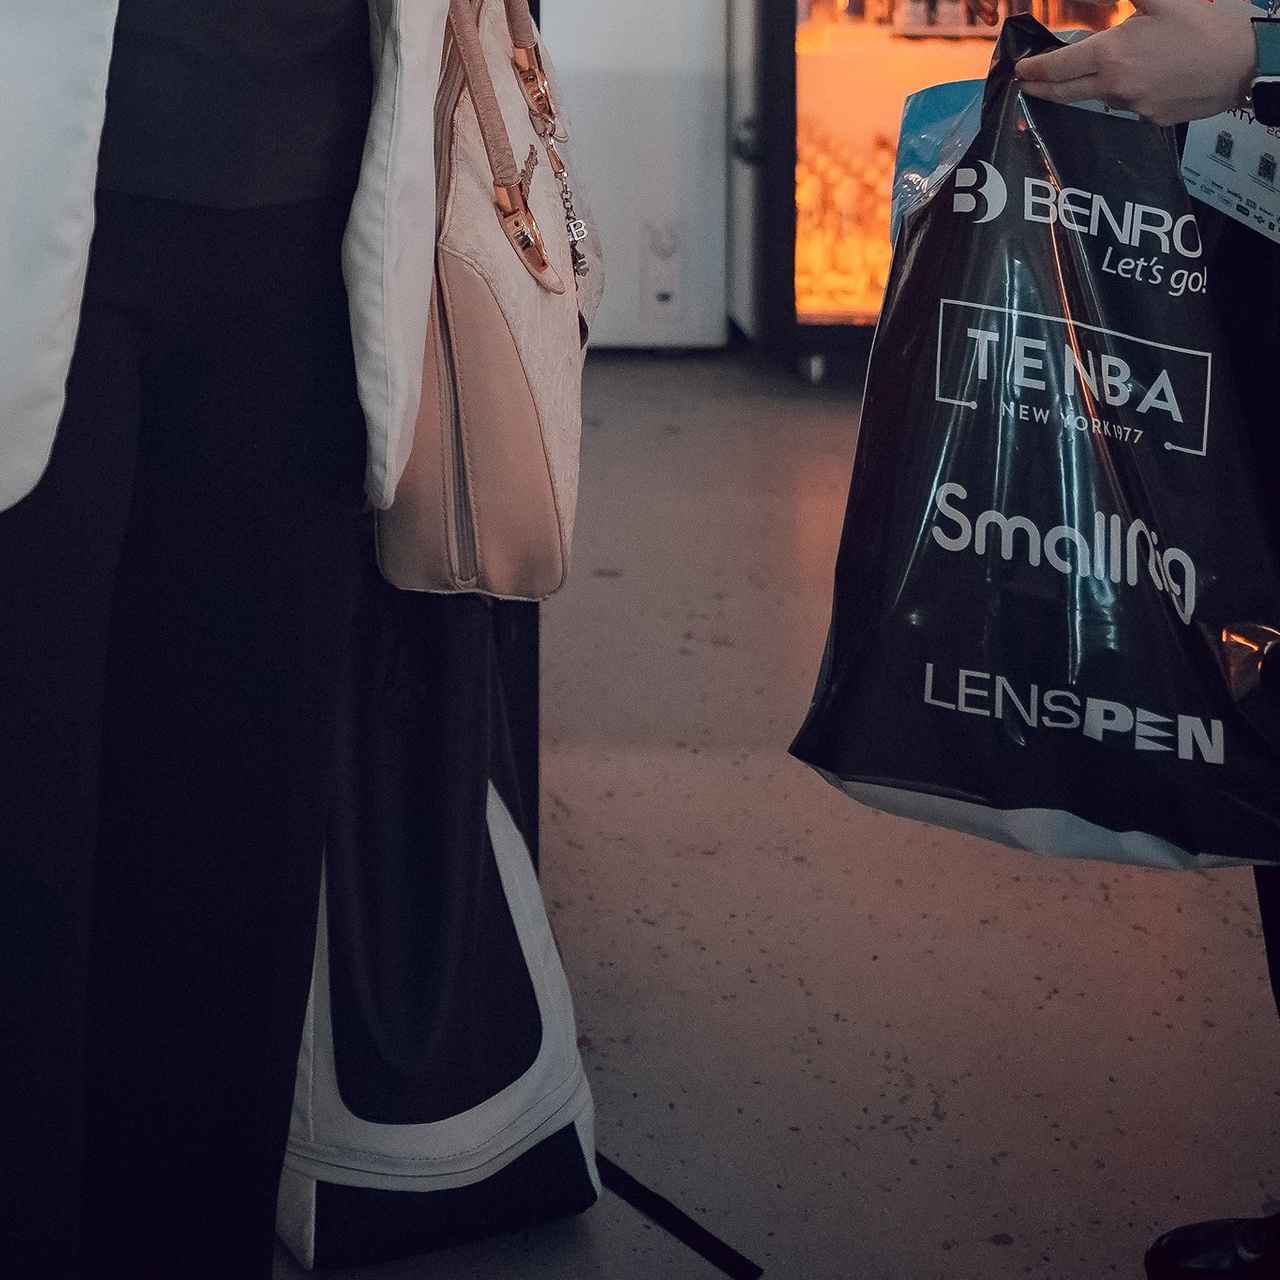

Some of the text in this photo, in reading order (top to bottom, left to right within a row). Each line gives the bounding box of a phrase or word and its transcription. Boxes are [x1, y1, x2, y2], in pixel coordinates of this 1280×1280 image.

[1024, 177, 1203, 258] BENRO
[1169, 268, 1208, 297] go!
[967, 328, 1183, 423] TENBA
[1001, 401, 1144, 444] NEW YORK 1977
[923, 663, 1225, 765] LENSPEN
